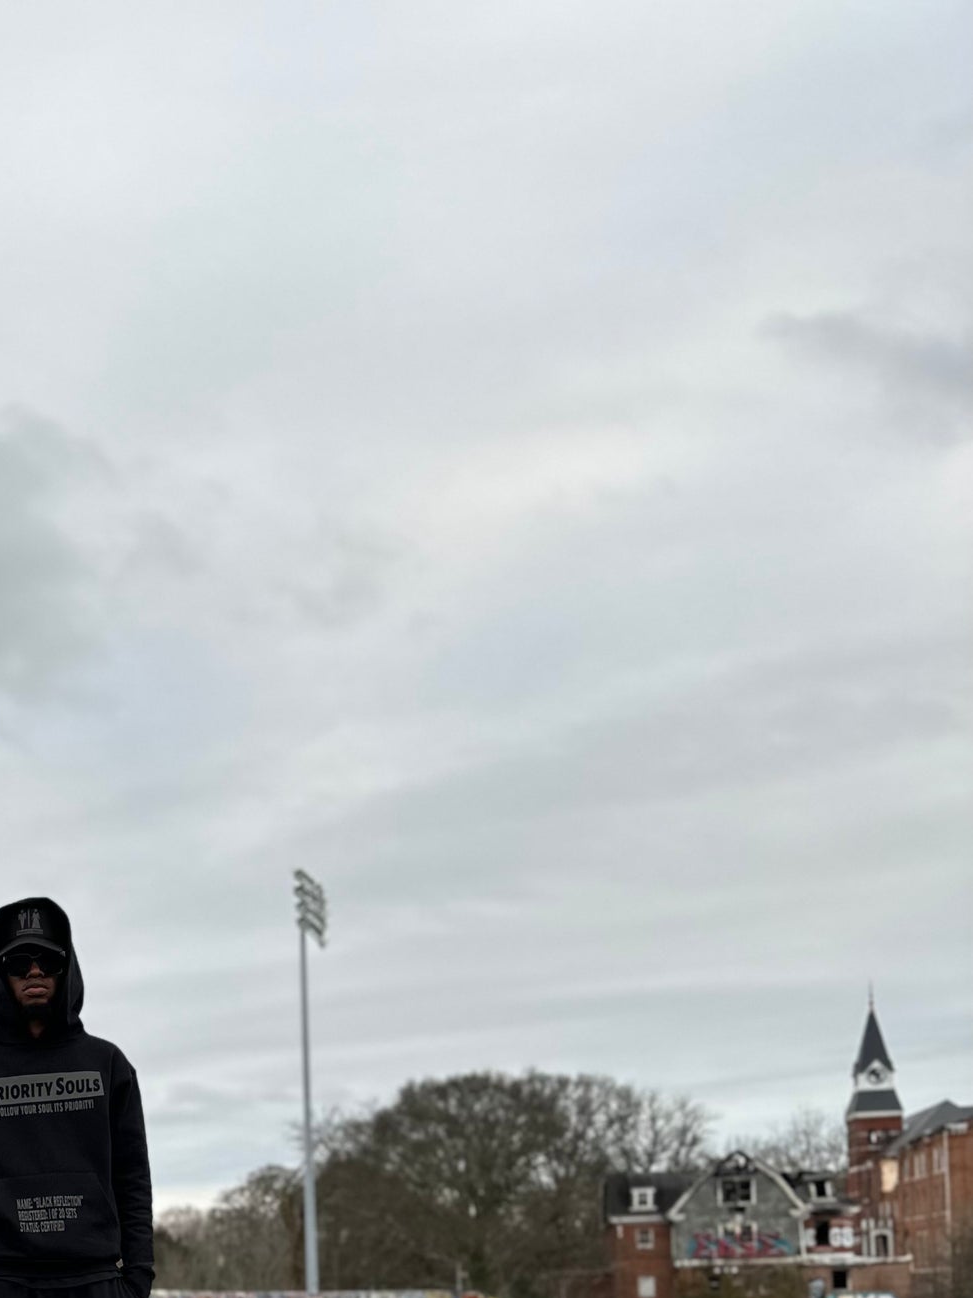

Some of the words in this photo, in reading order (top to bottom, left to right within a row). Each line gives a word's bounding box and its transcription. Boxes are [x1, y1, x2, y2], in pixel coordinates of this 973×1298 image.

[20, 1104, 37, 1115] YOUR
[37, 1103, 53, 1114] SOUL
[53, 1102, 64, 1113] ITS
[16, 1198, 33, 1209] NAME:
[51, 1208, 58, 1219] OF
[58, 1208, 65, 1218] 20
[65, 1207, 78, 1218] SETS
[19, 1222, 40, 1233] STATUS:
[40, 1220, 66, 1232] CERTIFIED
